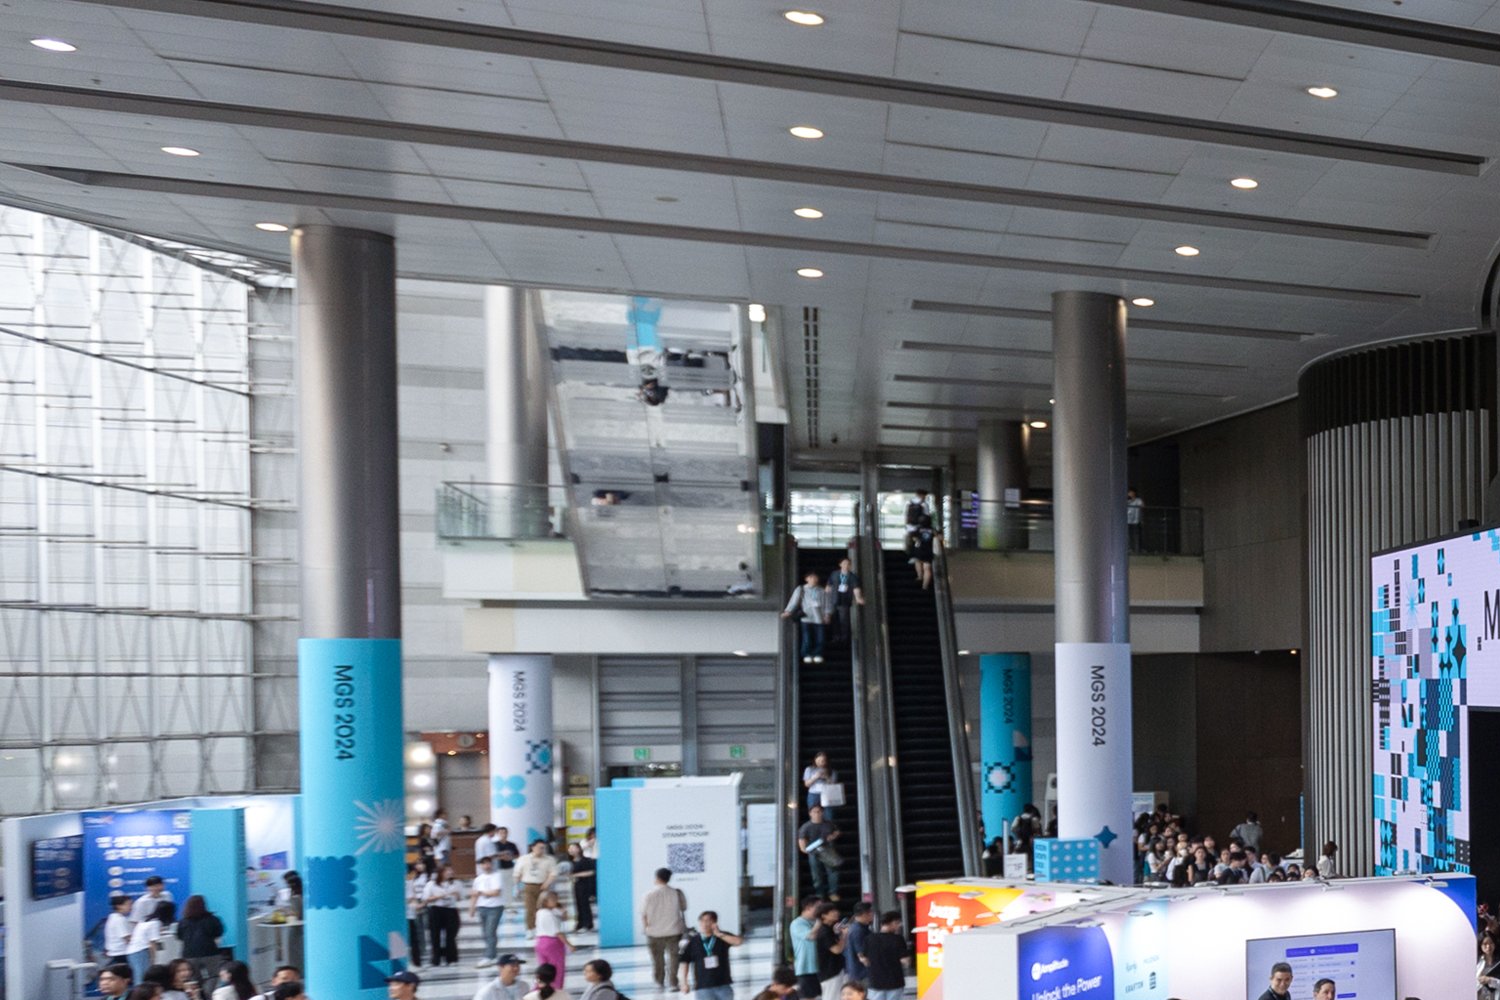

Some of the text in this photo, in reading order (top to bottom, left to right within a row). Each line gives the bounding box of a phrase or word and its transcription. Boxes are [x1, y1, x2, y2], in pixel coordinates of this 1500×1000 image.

[333, 665, 355, 760] MGS 2024
[512, 670, 527, 732] MGS 2024
[1003, 668, 1014, 724] MGS 2024
[1090, 665, 1107, 747] MGS 2024
[1062, 983, 1077, 998] the
[1077, 975, 1102, 993] Power
